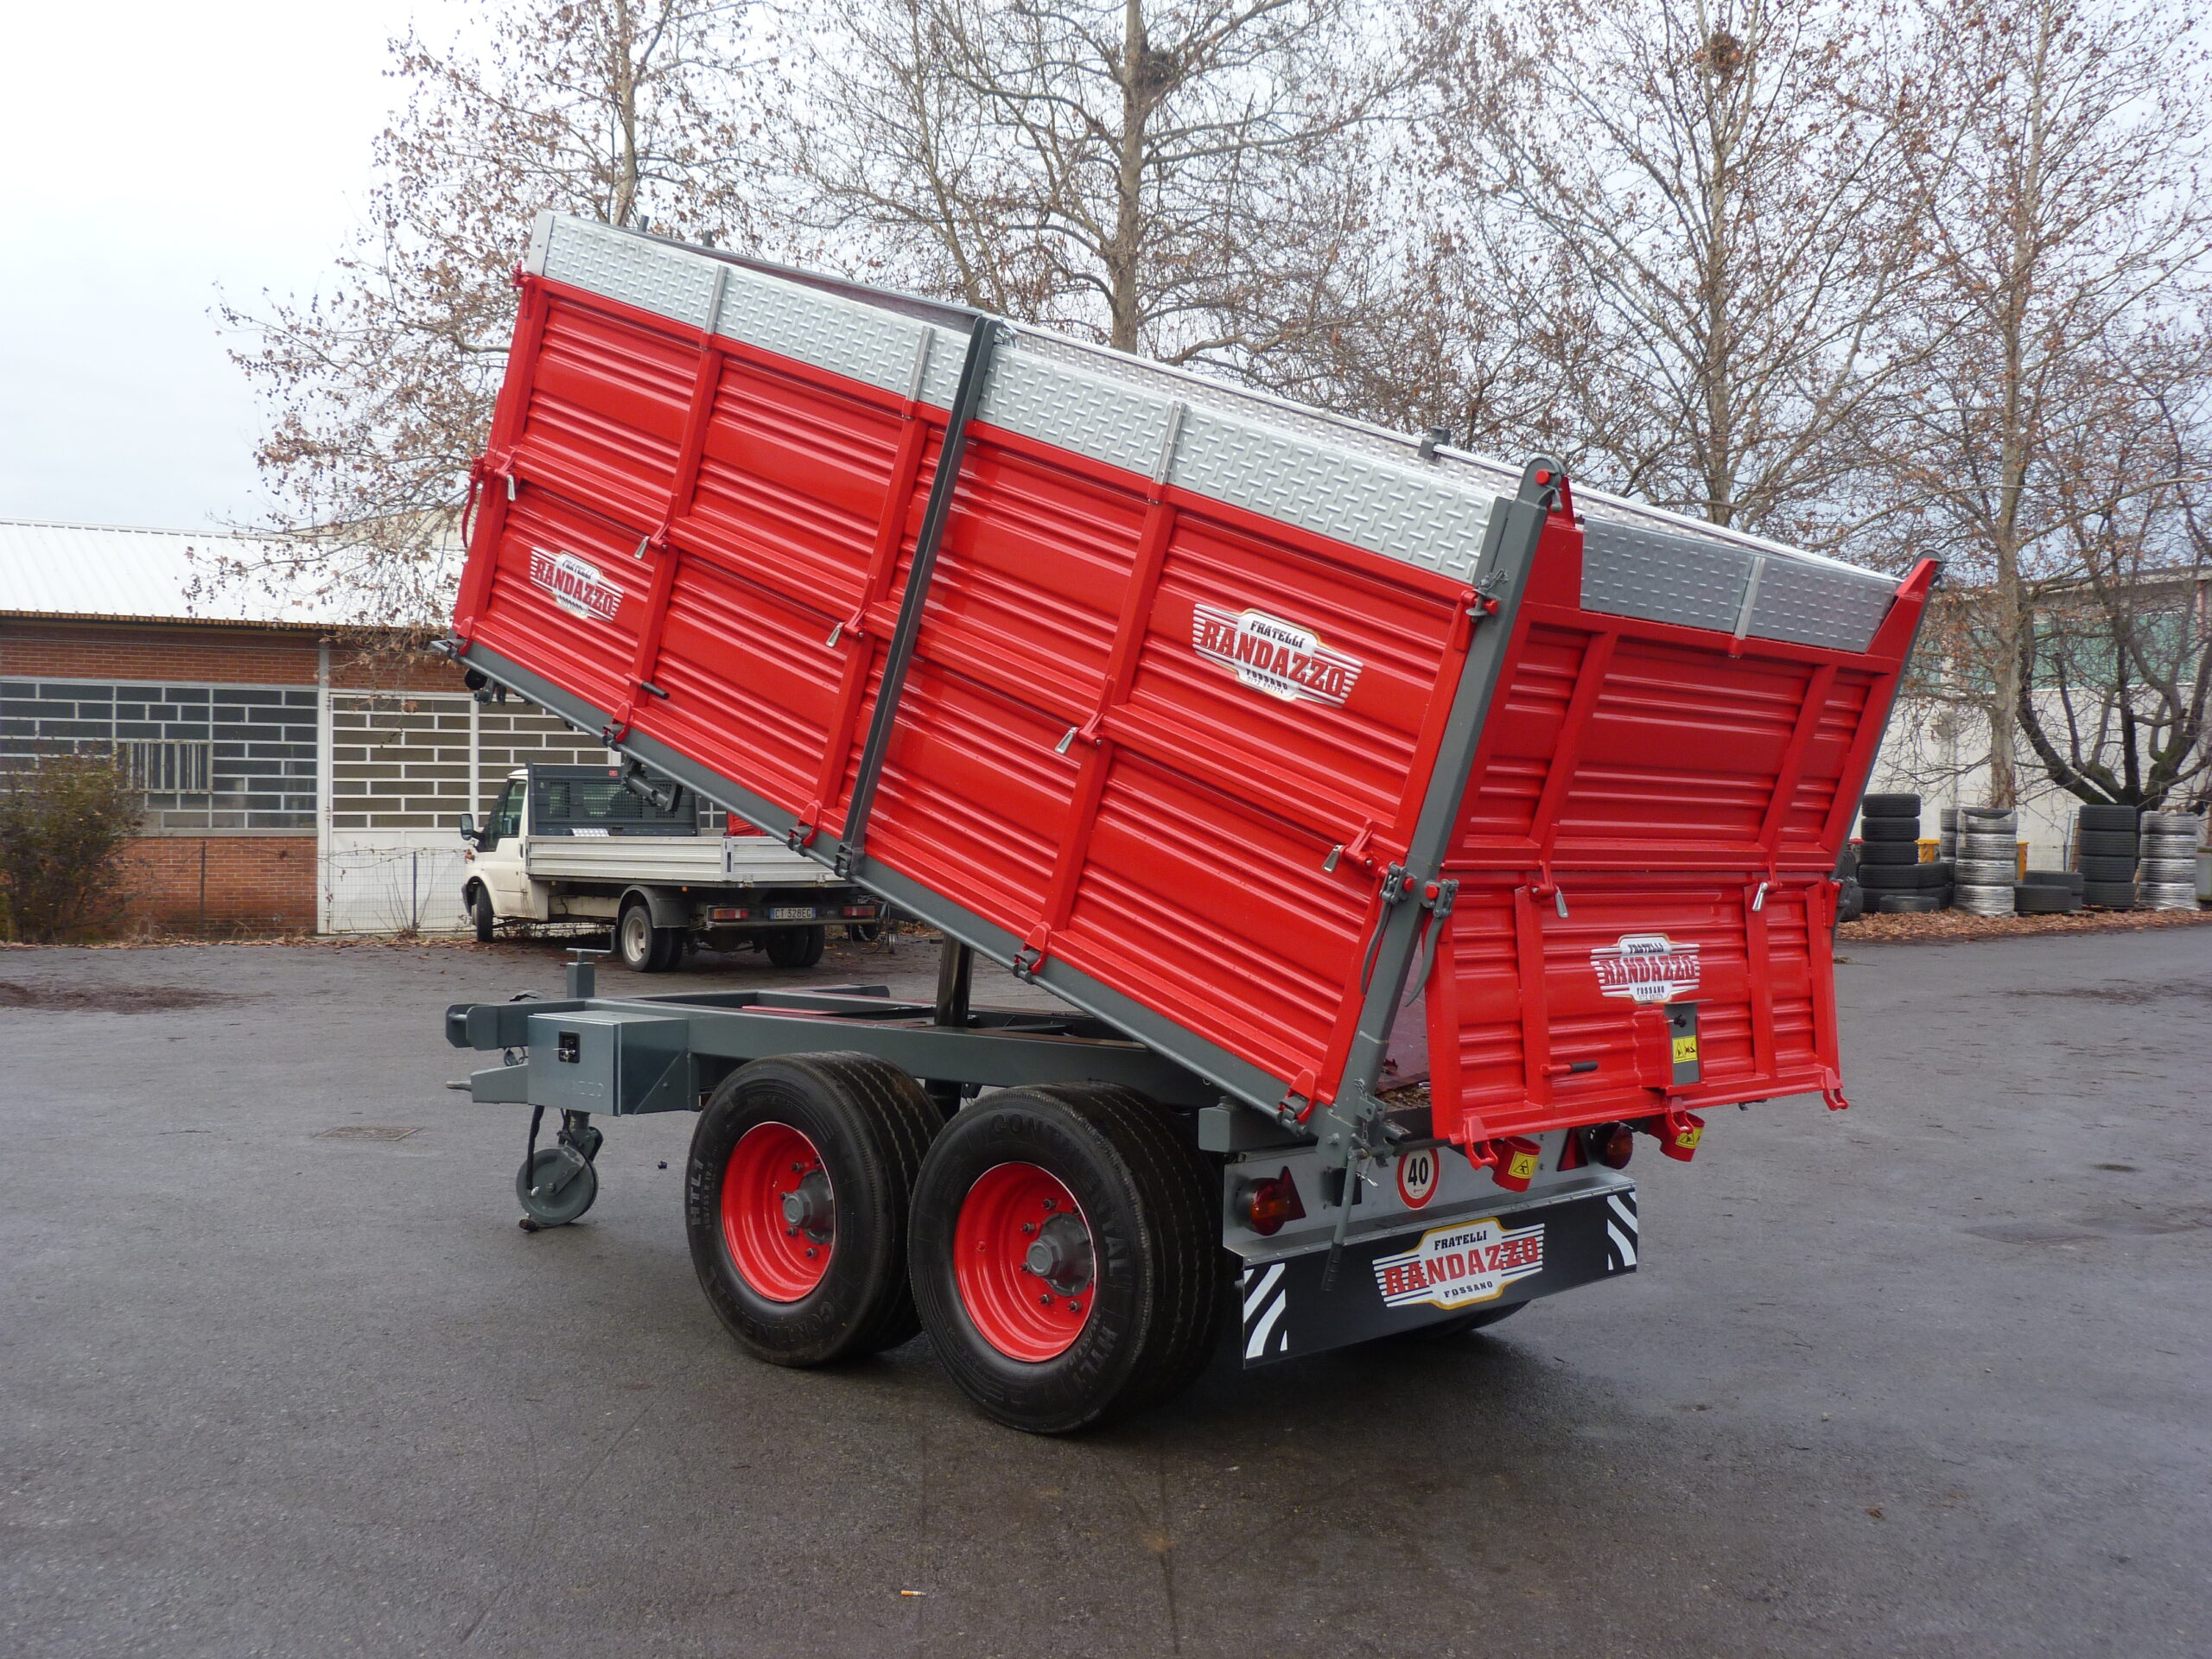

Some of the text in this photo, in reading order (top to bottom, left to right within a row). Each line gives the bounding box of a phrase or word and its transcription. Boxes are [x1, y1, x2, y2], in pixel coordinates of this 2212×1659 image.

[534, 559, 614, 614] RANDAZZO
[1250, 620, 1306, 648] FRATELLI
[1200, 620, 1346, 696] RANDAZZO
[1246, 668, 1288, 690] FOSSANO
[775, 908, 811, 918] CT 328EG
[1628, 943, 1664, 954] FRATELLI
[1599, 954, 1696, 985] RANDAZZO
[1637, 986, 1665, 995] FOSSANO
[1408, 1156, 1429, 1186] 40
[690, 1157, 705, 1226] HTL1
[991, 1114, 1128, 1276] CONTENTAL
[1434, 1230, 1487, 1251] FRATELLI
[1383, 1236, 1539, 1296] RANDAZZO
[1443, 1281, 1493, 1299] FOSSANO
